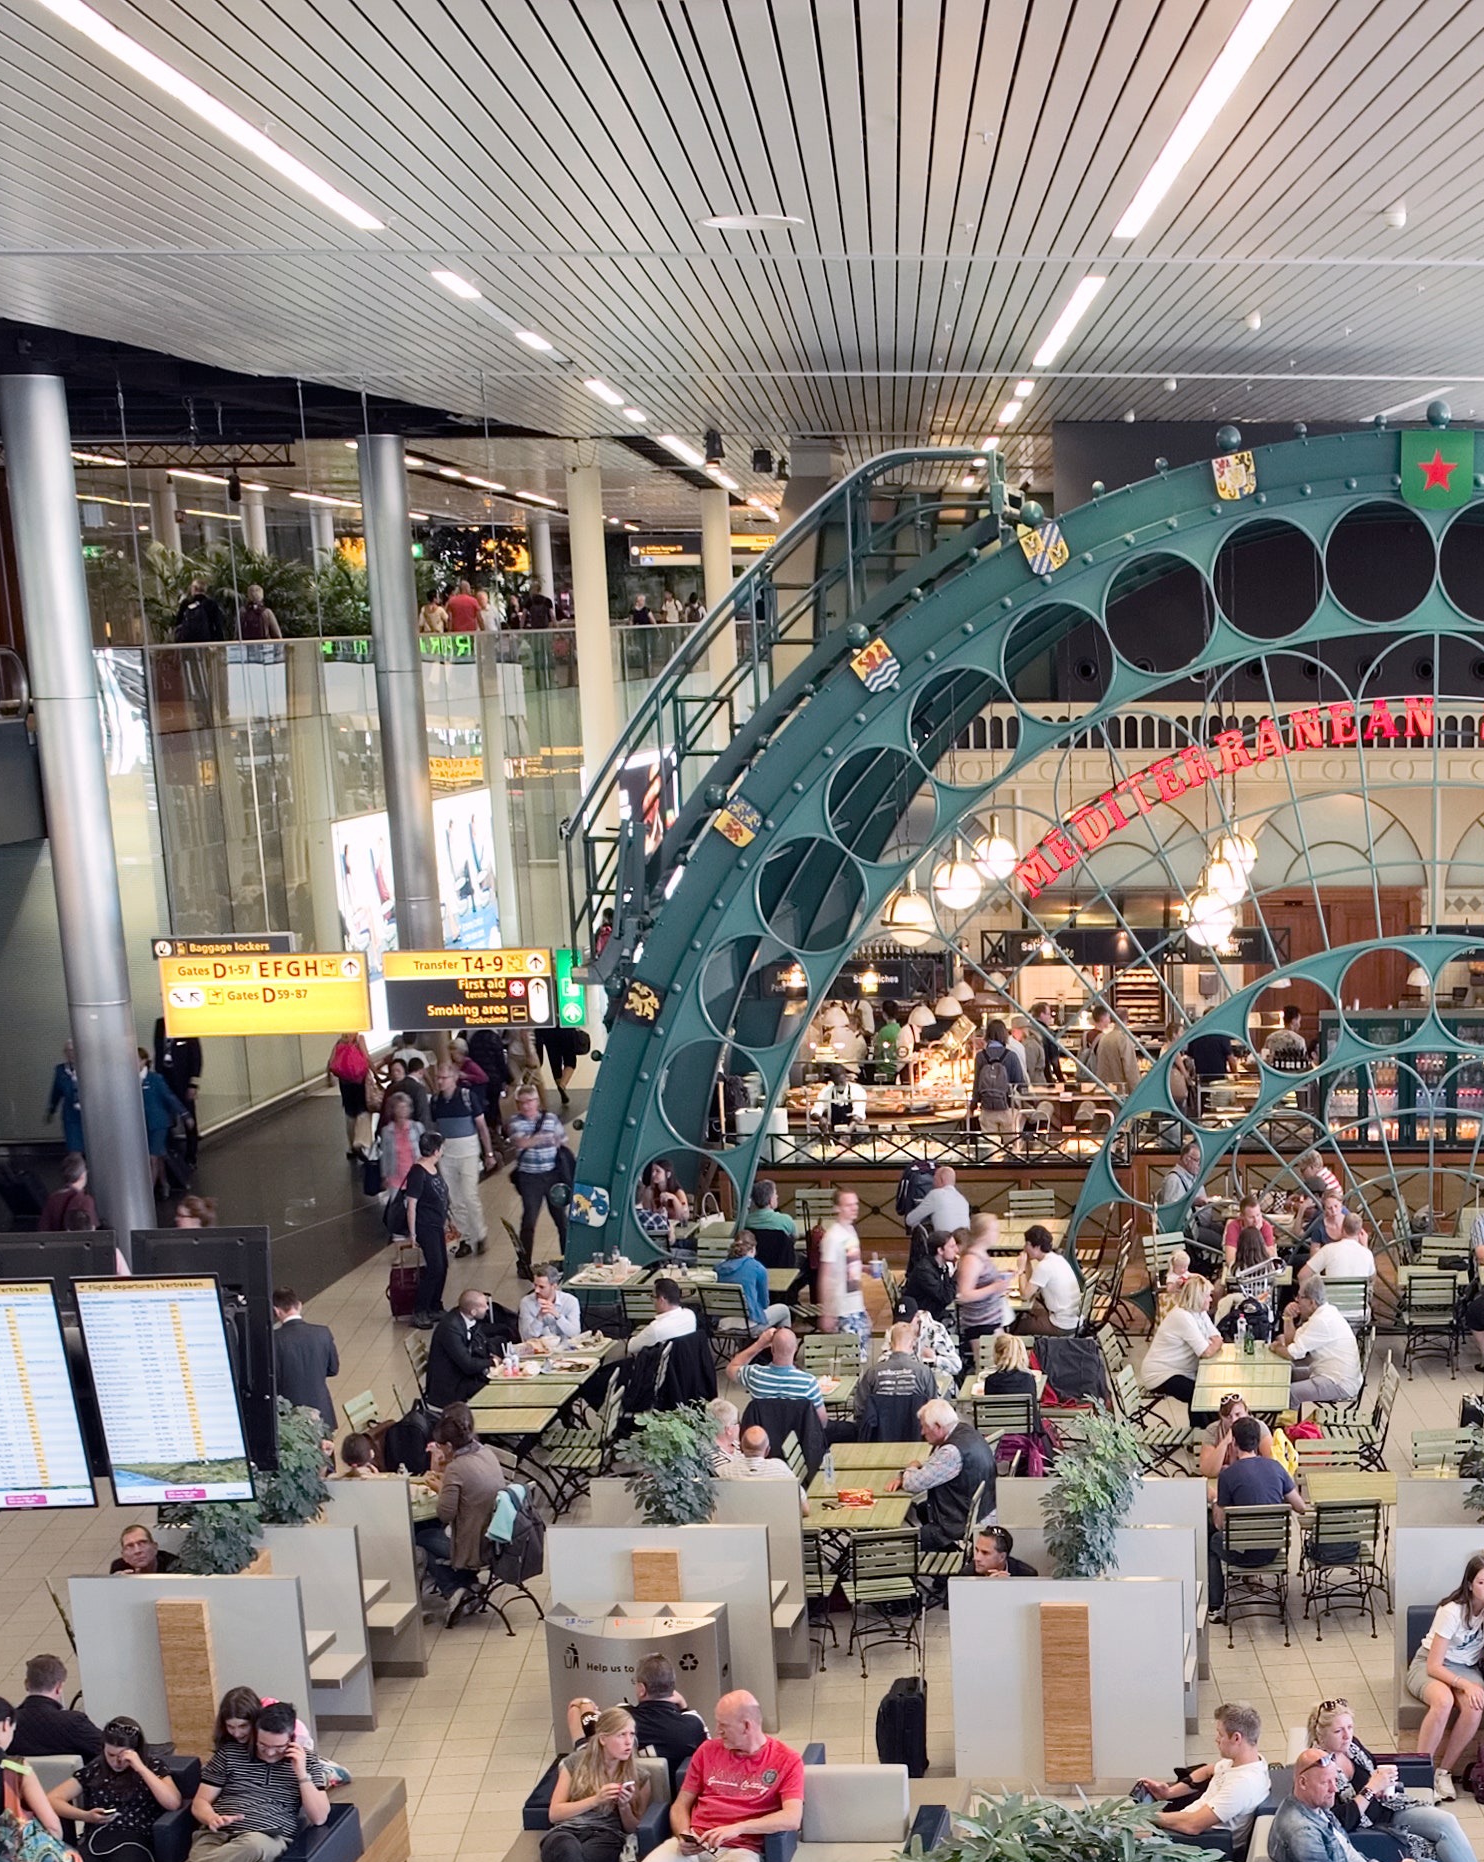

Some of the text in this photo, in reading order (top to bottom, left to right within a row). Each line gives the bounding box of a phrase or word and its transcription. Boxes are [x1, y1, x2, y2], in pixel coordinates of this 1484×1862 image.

[1016, 696, 1434, 899] MEDITERRANEAN
[189, 941, 270, 955] Baggage lockers
[177, 966, 210, 976] Gates
[413, 956, 504, 973] Transfer T4-9
[458, 978, 506, 990] First aid
[227, 990, 259, 1001] Gates
[427, 1003, 509, 1017] Smoking area
[586, 1662, 635, 1673] Help us to
